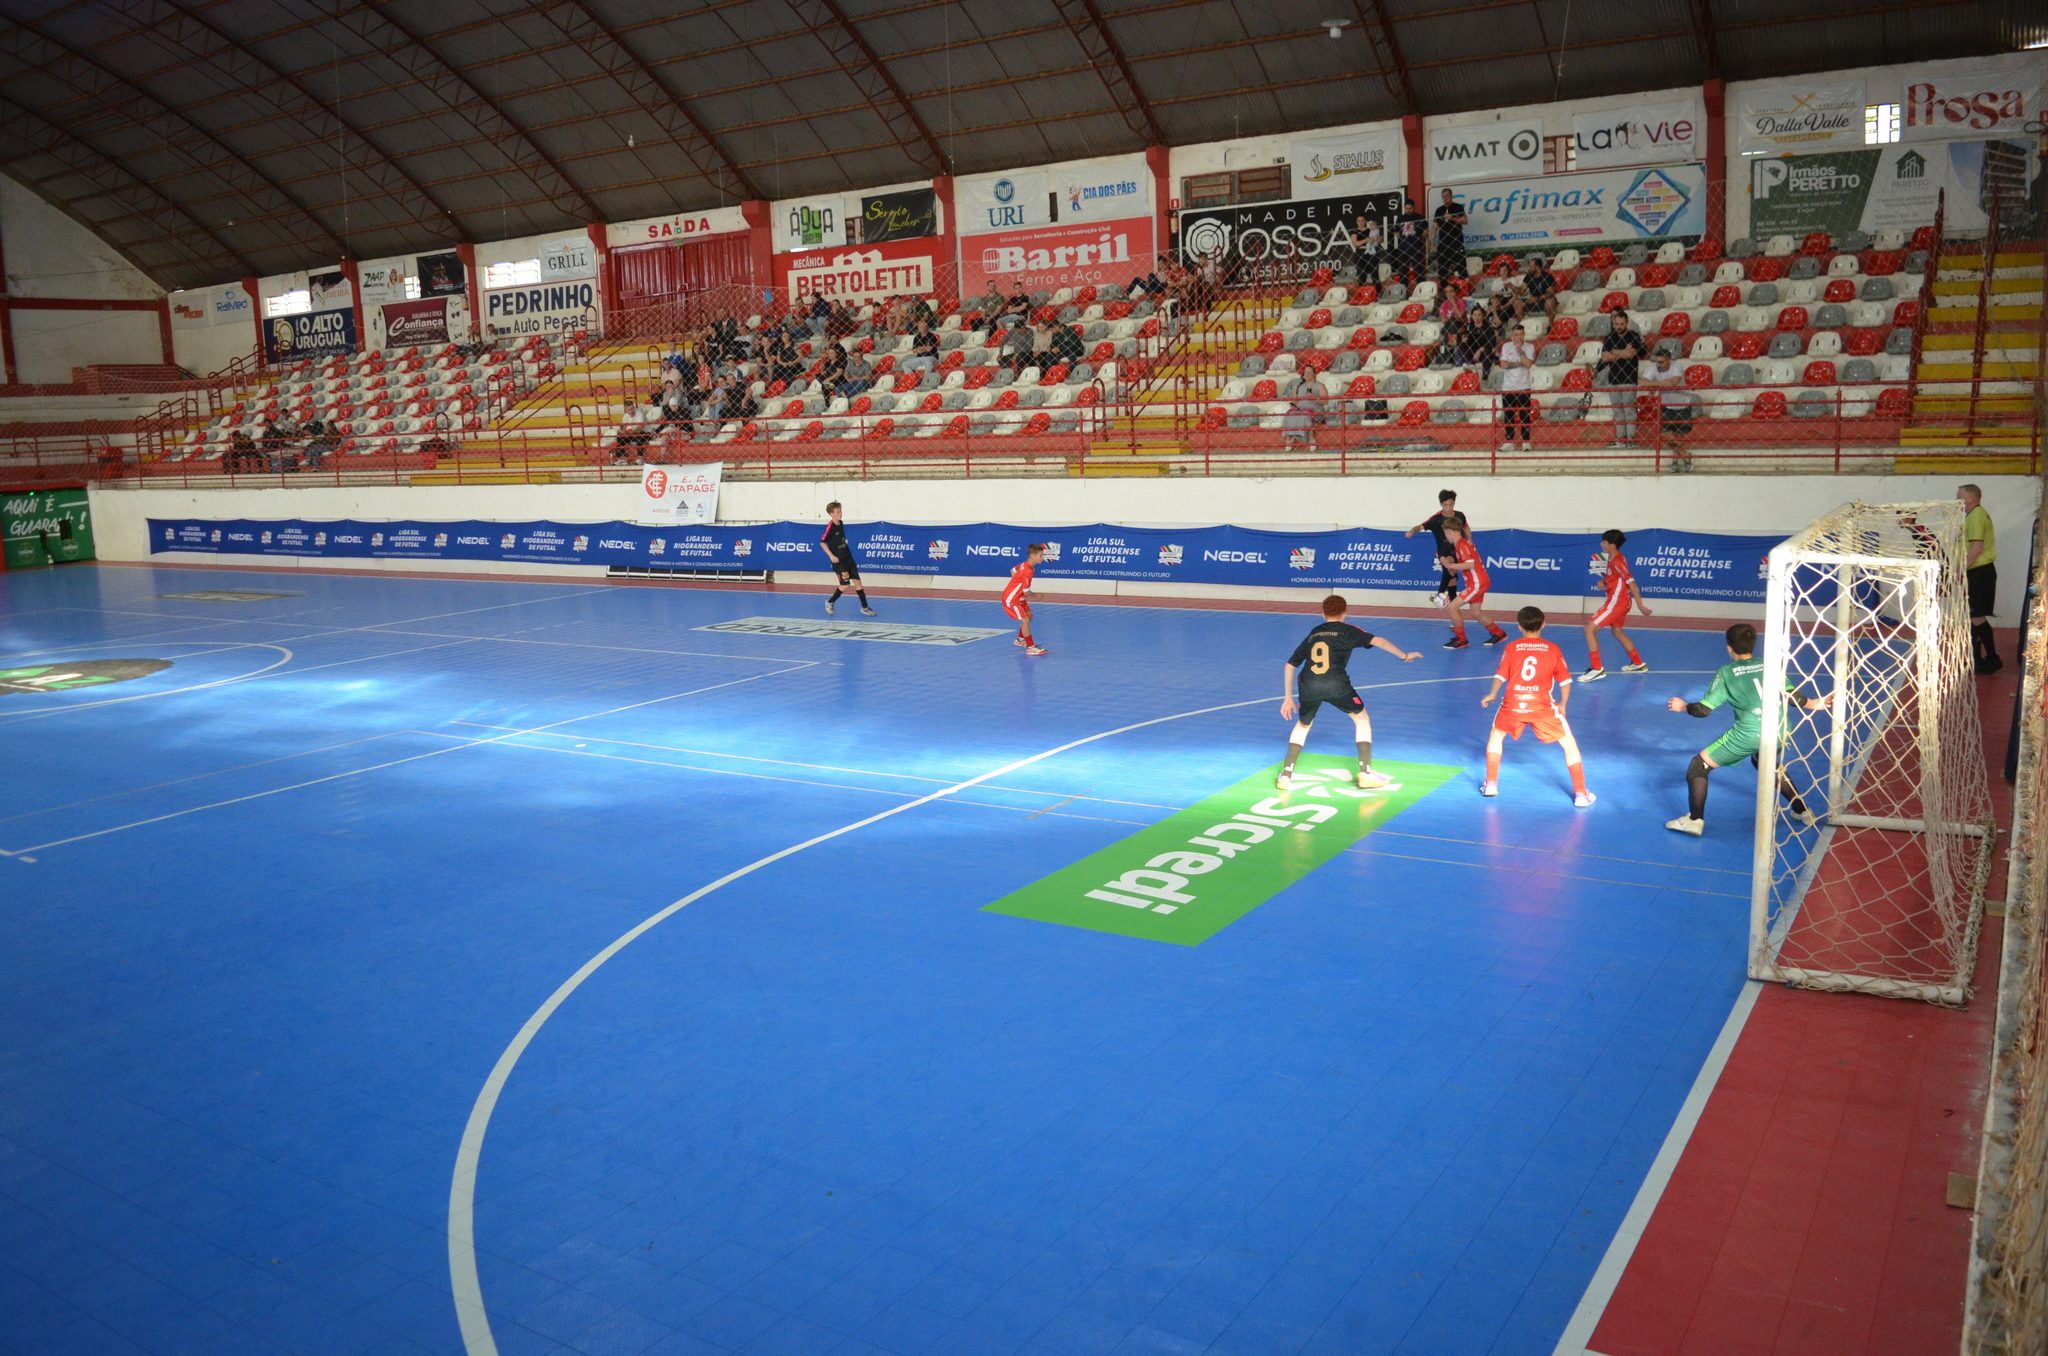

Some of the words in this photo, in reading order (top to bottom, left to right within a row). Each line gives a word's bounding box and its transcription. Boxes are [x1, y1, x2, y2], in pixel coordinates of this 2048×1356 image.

[1907, 83, 2024, 129] Prosa
[1756, 116, 1804, 135] Dalla
[1804, 113, 1850, 131] Valle
[1334, 150, 1384, 170] STALUS
[1790, 165, 1836, 178] Irmãos
[1789, 174, 1860, 191] PERETTO
[1083, 187, 1097, 199] CIA
[1100, 185, 1115, 198] DOS
[1117, 181, 1137, 196] PÃES
[988, 205, 1025, 228] URI
[1240, 199, 1399, 224] MADEIRAS
[999, 232, 1130, 273] Barril
[548, 253, 588, 270] GRILL
[793, 256, 825, 268] MECÂNICA
[797, 265, 921, 298] BERTOLETTI
[1017, 273, 1055, 287] Ferro
[1061, 273, 1068, 282] e
[1074, 269, 1102, 285] Aço
[489, 284, 593, 317] PEDRINHO
[311, 312, 344, 334] ALTO
[388, 316, 444, 337] Confiança
[514, 317, 540, 333] Auto
[296, 331, 346, 350] URUGUAI
[45, 494, 54, 513] É
[334, 535, 363, 543] NEDEL
[457, 536, 489, 545] NEDEL
[523, 537, 565, 545] RIOGRANDENSE
[599, 539, 636, 550] NEDEL
[871, 534, 888, 543] LIGA
[889, 535, 903, 543] SUL
[1088, 537, 1108, 547] LIGA
[1109, 538, 1125, 547] SUL
[674, 542, 723, 550] RIOGRANDENSE
[766, 542, 813, 553] NEDEL
[858, 542, 915, 551] RIOGRANDENSE
[966, 545, 1020, 557] NEDEL
[1072, 546, 1141, 556] RIOGRANDENSE
[1347, 542, 1371, 552] LIGA
[1373, 543, 1394, 553] SUL
[1656, 545, 1686, 556] LIGA
[1687, 547, 1711, 558] SUL
[866, 550, 877, 558] DE
[878, 551, 904, 559] FUTSAL
[1082, 554, 1097, 563] DE
[1098, 555, 1127, 564] FUTSAL
[1203, 549, 1266, 563] NEDEL
[1327, 551, 1412, 563] RIOGRANDENSE
[1339, 561, 1354, 570] DE
[1356, 561, 1396, 572] FUTSAL
[1486, 556, 1561, 571] NEDEL
[1635, 556, 1732, 569] RIOGRANDENSE
[1077, 568, 1099, 576] HISTÓRIA
[1103, 570, 1141, 578] CONSTRUINDO
[1649, 567, 1666, 577] DE
[1668, 567, 1714, 580] FUTSAL
[1291, 576, 1326, 584] HONRANDO
[1333, 576, 1361, 585] HISTÓRIA
[1366, 578, 1412, 586] CONSTRUINDO
[1641, 584, 1673, 594] HISTÓRIA
[1681, 586, 1735, 597] CONSTRUINDO
[1743, 589, 1768, 598] FUTUR
[706, 621, 983, 646] METALFRED
[1311, 641, 1329, 675] 9
[1521, 655, 1537, 681] 6
[1084, 795, 1339, 915] Sicredi
